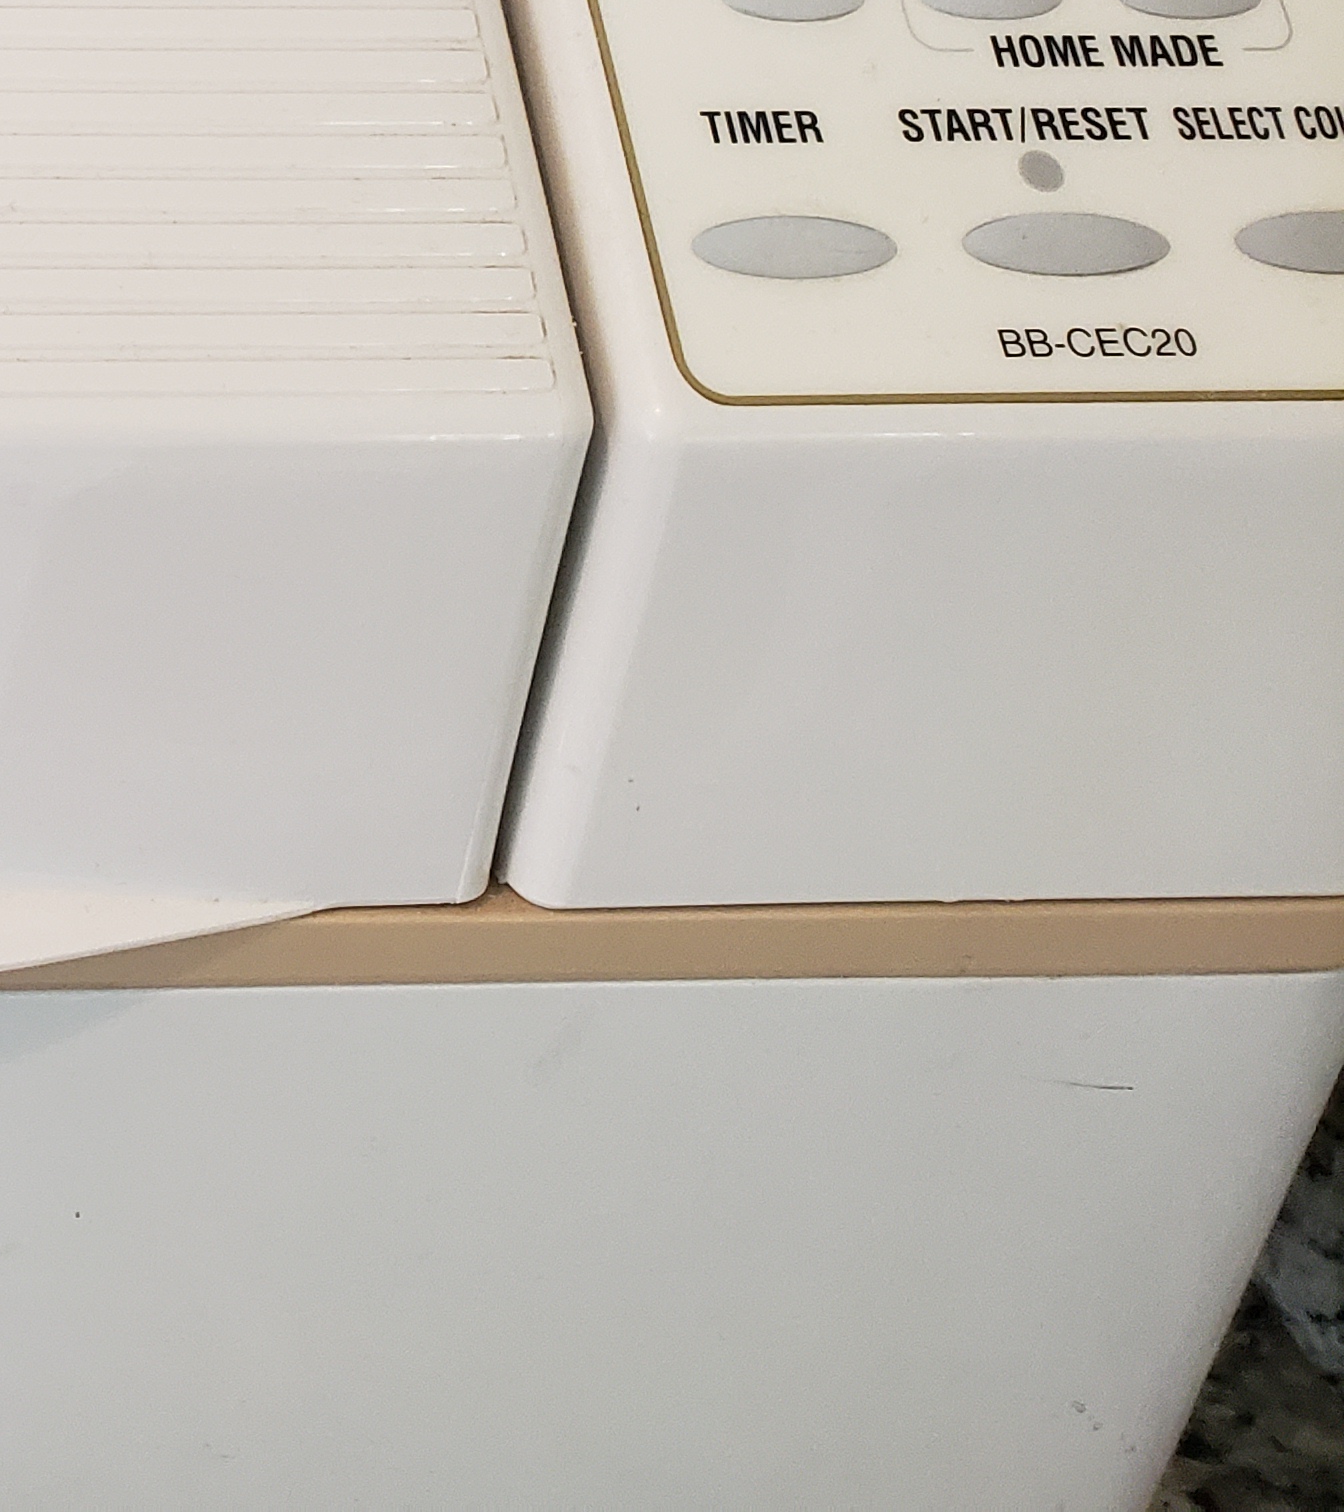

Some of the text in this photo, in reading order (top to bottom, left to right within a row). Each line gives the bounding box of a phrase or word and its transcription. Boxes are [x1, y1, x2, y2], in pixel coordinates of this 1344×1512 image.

[989, 35, 1224, 68] HOME MADE
[699, 110, 825, 144] TIMER
[898, 106, 1150, 143] START/RESET
[1172, 106, 1286, 140] SELECT
[996, 326, 1199, 358] BB-CEC20
